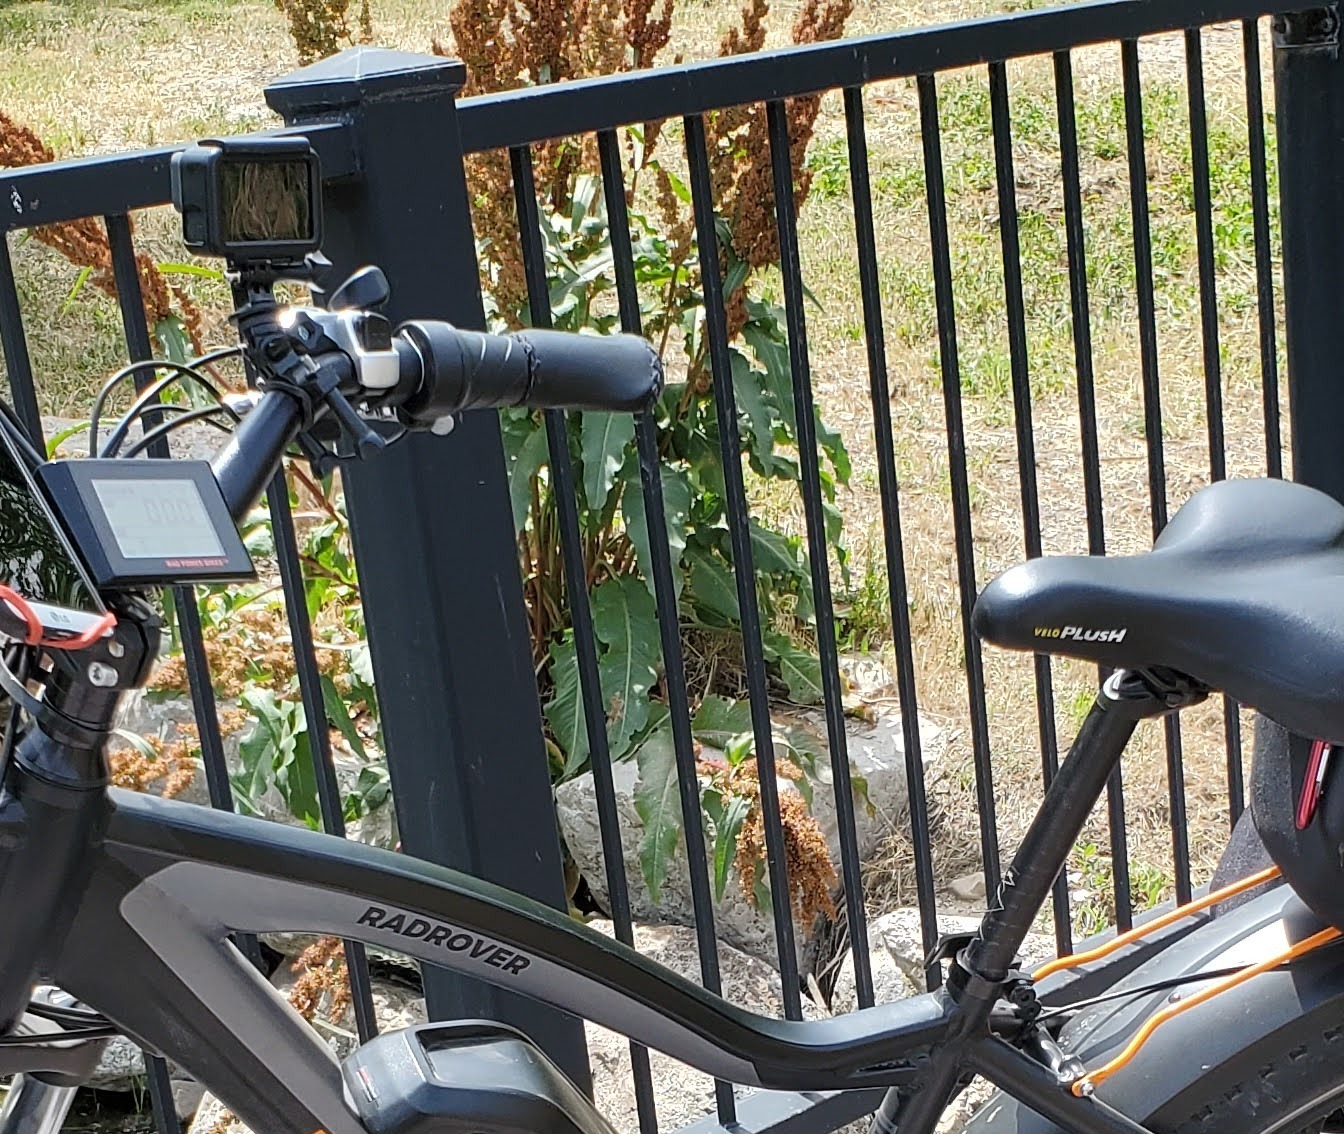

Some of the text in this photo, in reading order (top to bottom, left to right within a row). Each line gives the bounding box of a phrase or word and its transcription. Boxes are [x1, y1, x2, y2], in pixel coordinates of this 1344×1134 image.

[1034, 625, 1127, 643] VELO PLUSH
[356, 906, 532, 976] RADROVER
